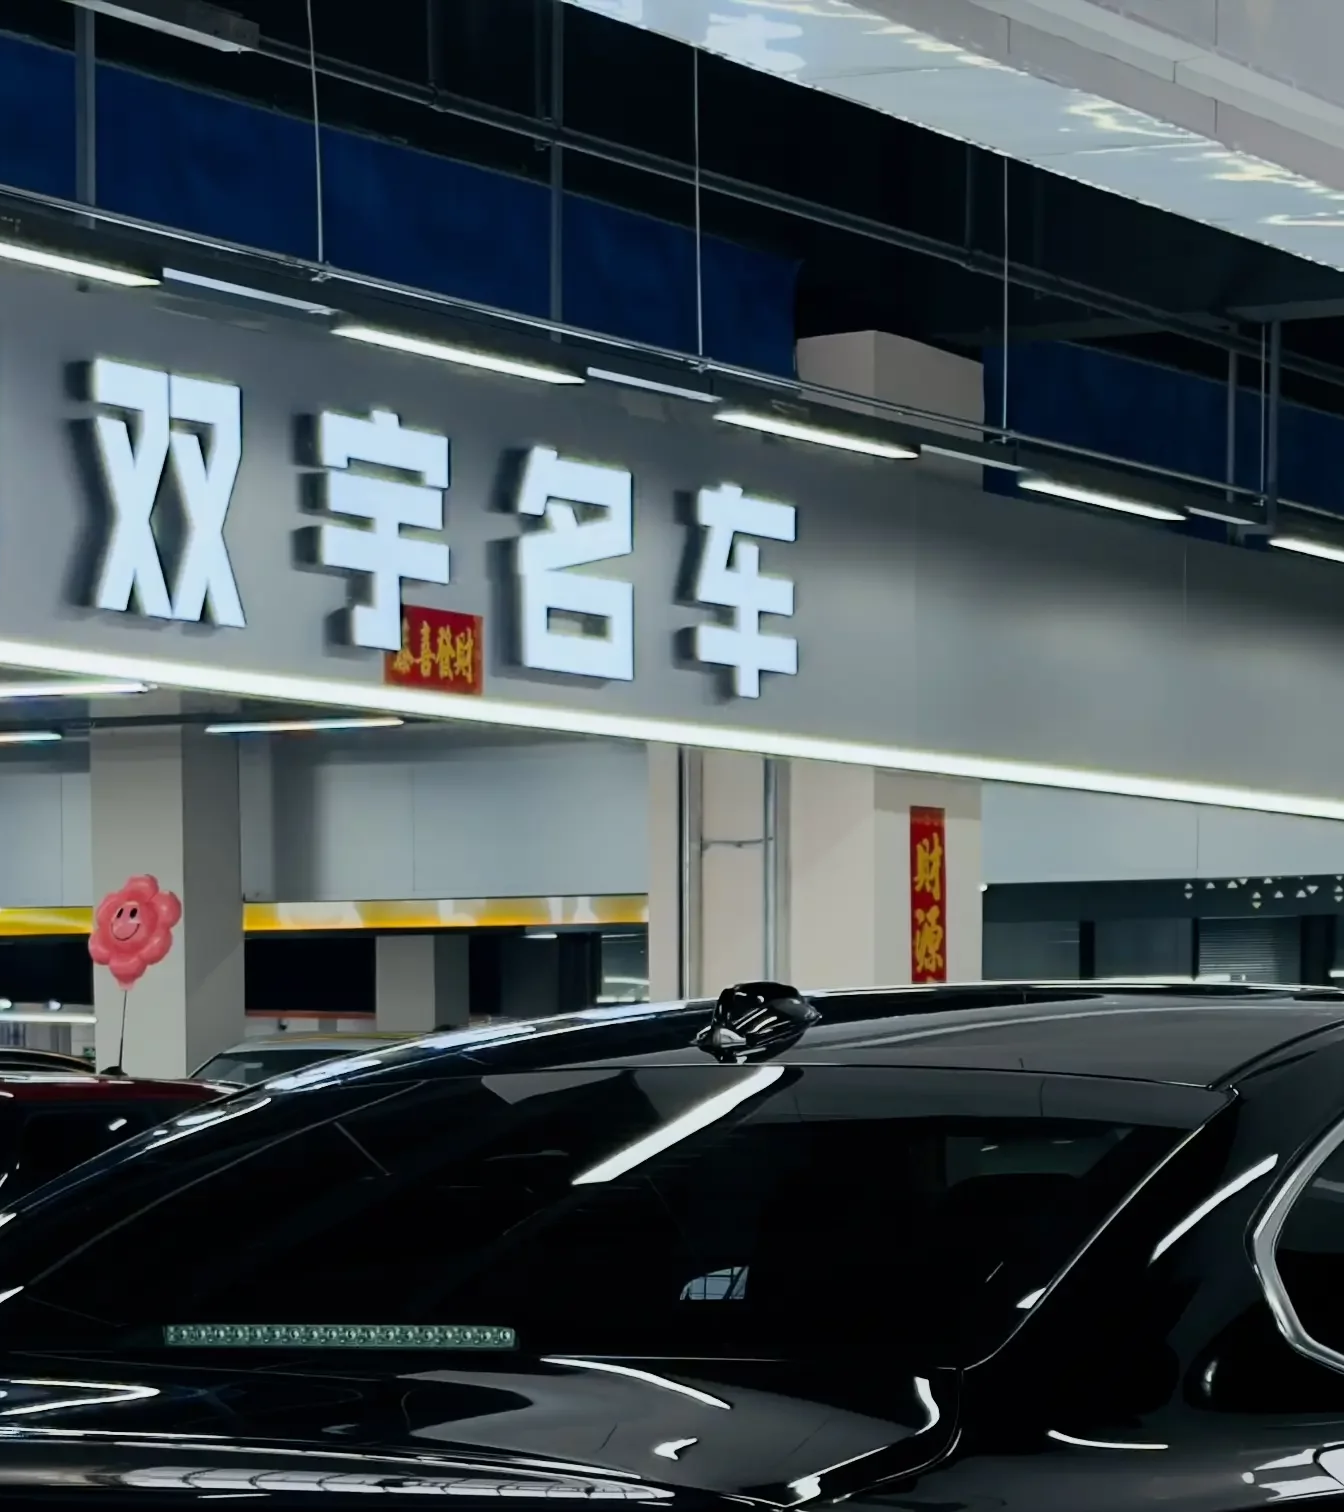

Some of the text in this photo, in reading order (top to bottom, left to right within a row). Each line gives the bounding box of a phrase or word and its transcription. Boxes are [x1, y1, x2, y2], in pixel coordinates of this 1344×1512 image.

[90, 355, 799, 699] 双宇名车
[913, 831, 944, 983] 財源
